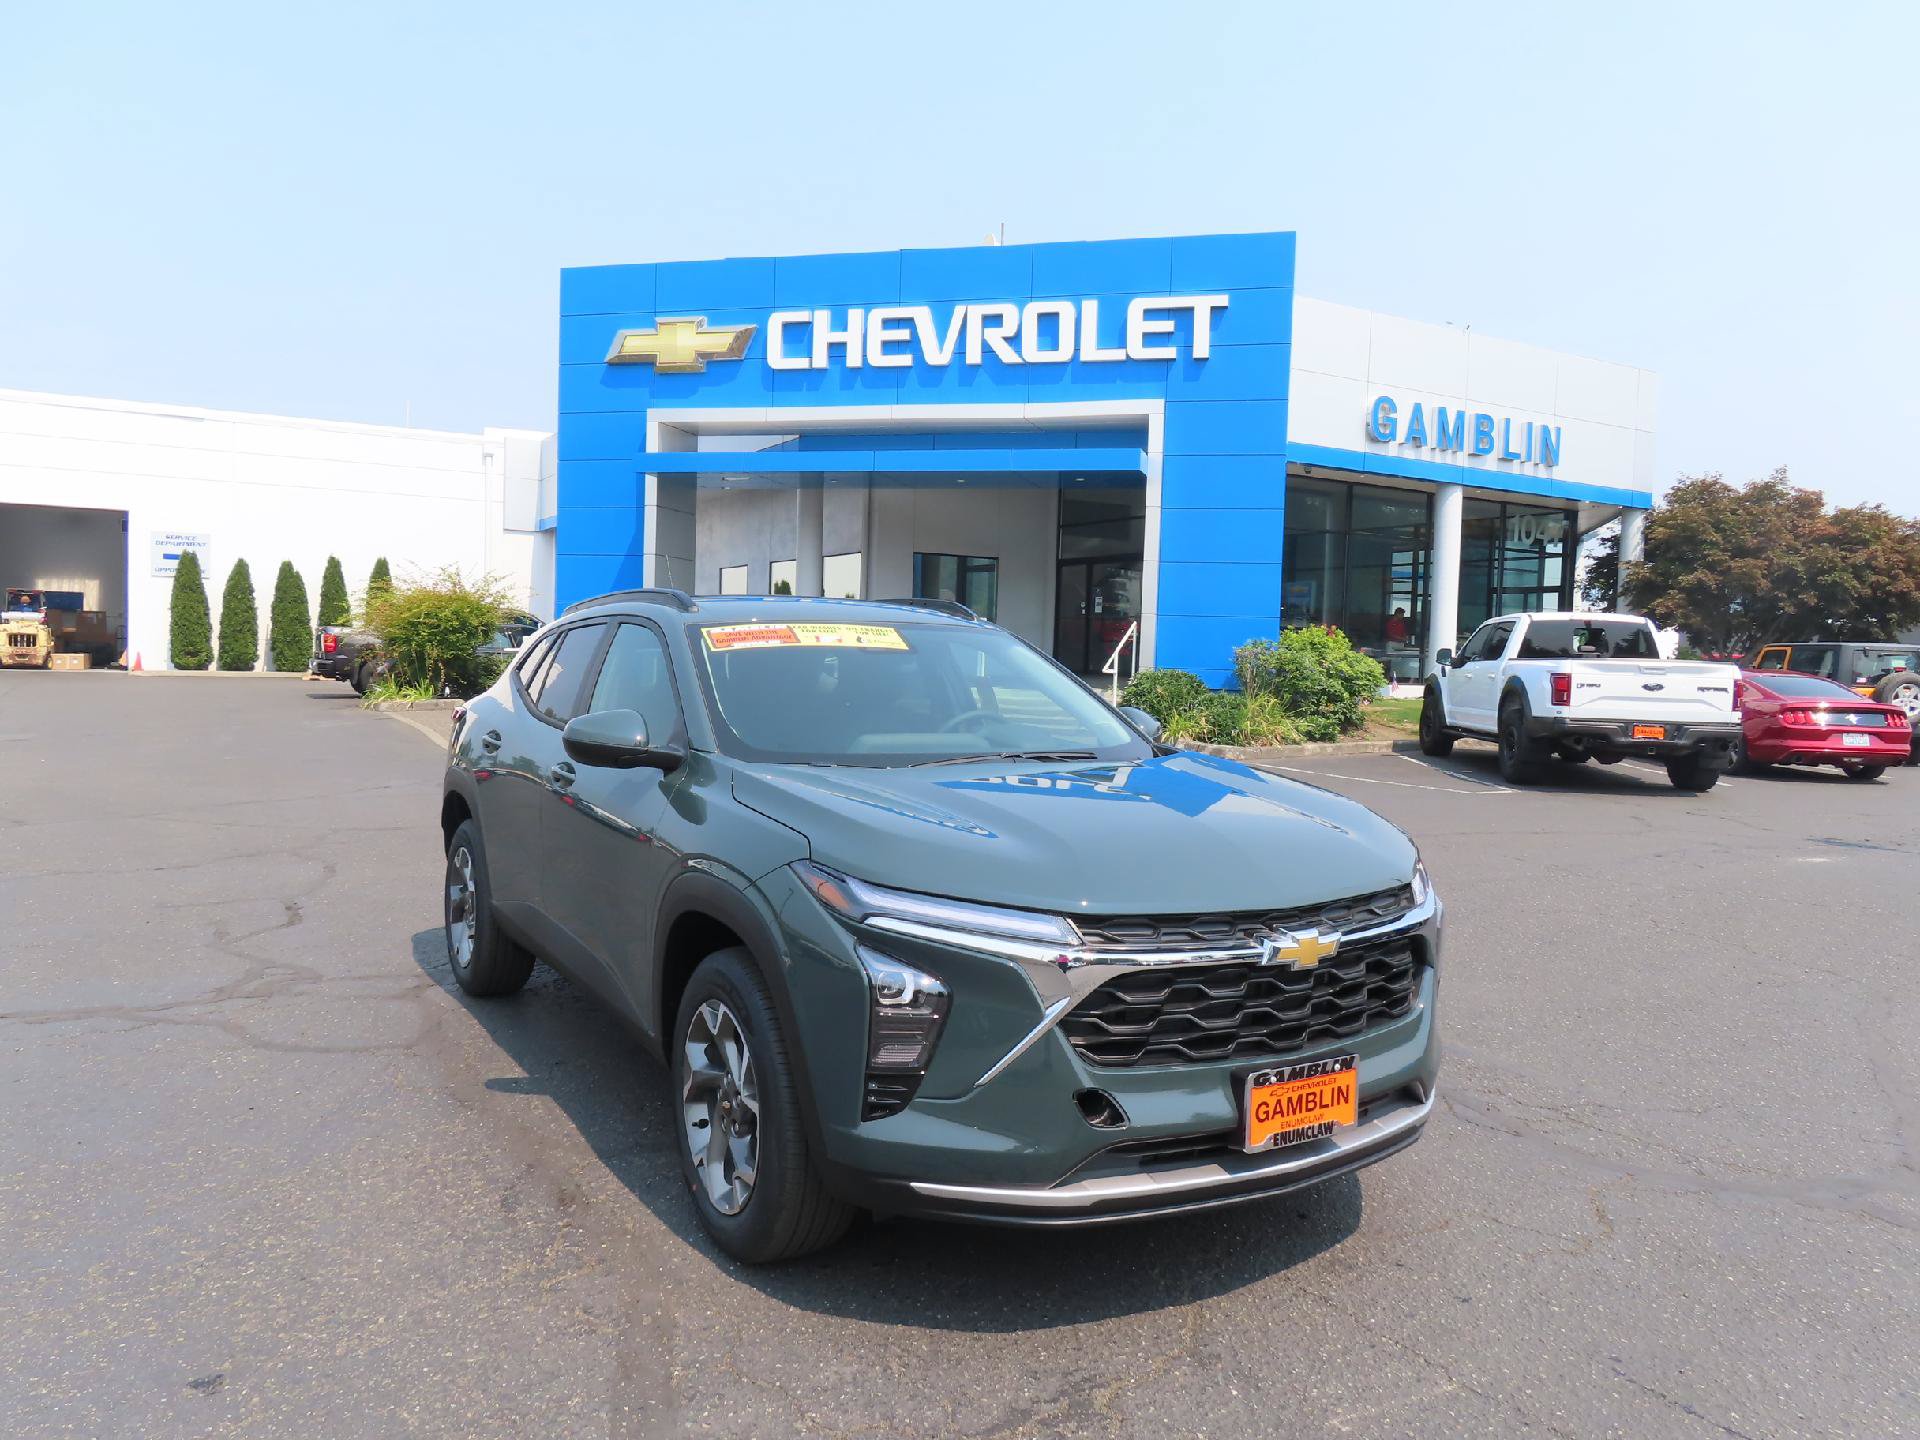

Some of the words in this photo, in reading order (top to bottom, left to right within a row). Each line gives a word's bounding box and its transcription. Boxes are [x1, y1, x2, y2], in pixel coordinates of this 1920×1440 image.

[767, 294, 1229, 371] CHEVROLET
[1367, 395, 1561, 468] GAMBLIN
[1254, 1056, 1356, 1087] GAMBLIN
[1291, 1077, 1337, 1092] CHEVROLET
[1255, 1085, 1350, 1123] GAMBLIN
[1273, 1120, 1335, 1146] ENUMCLAW
[1280, 1113, 1325, 1129] ENUMCLAW
